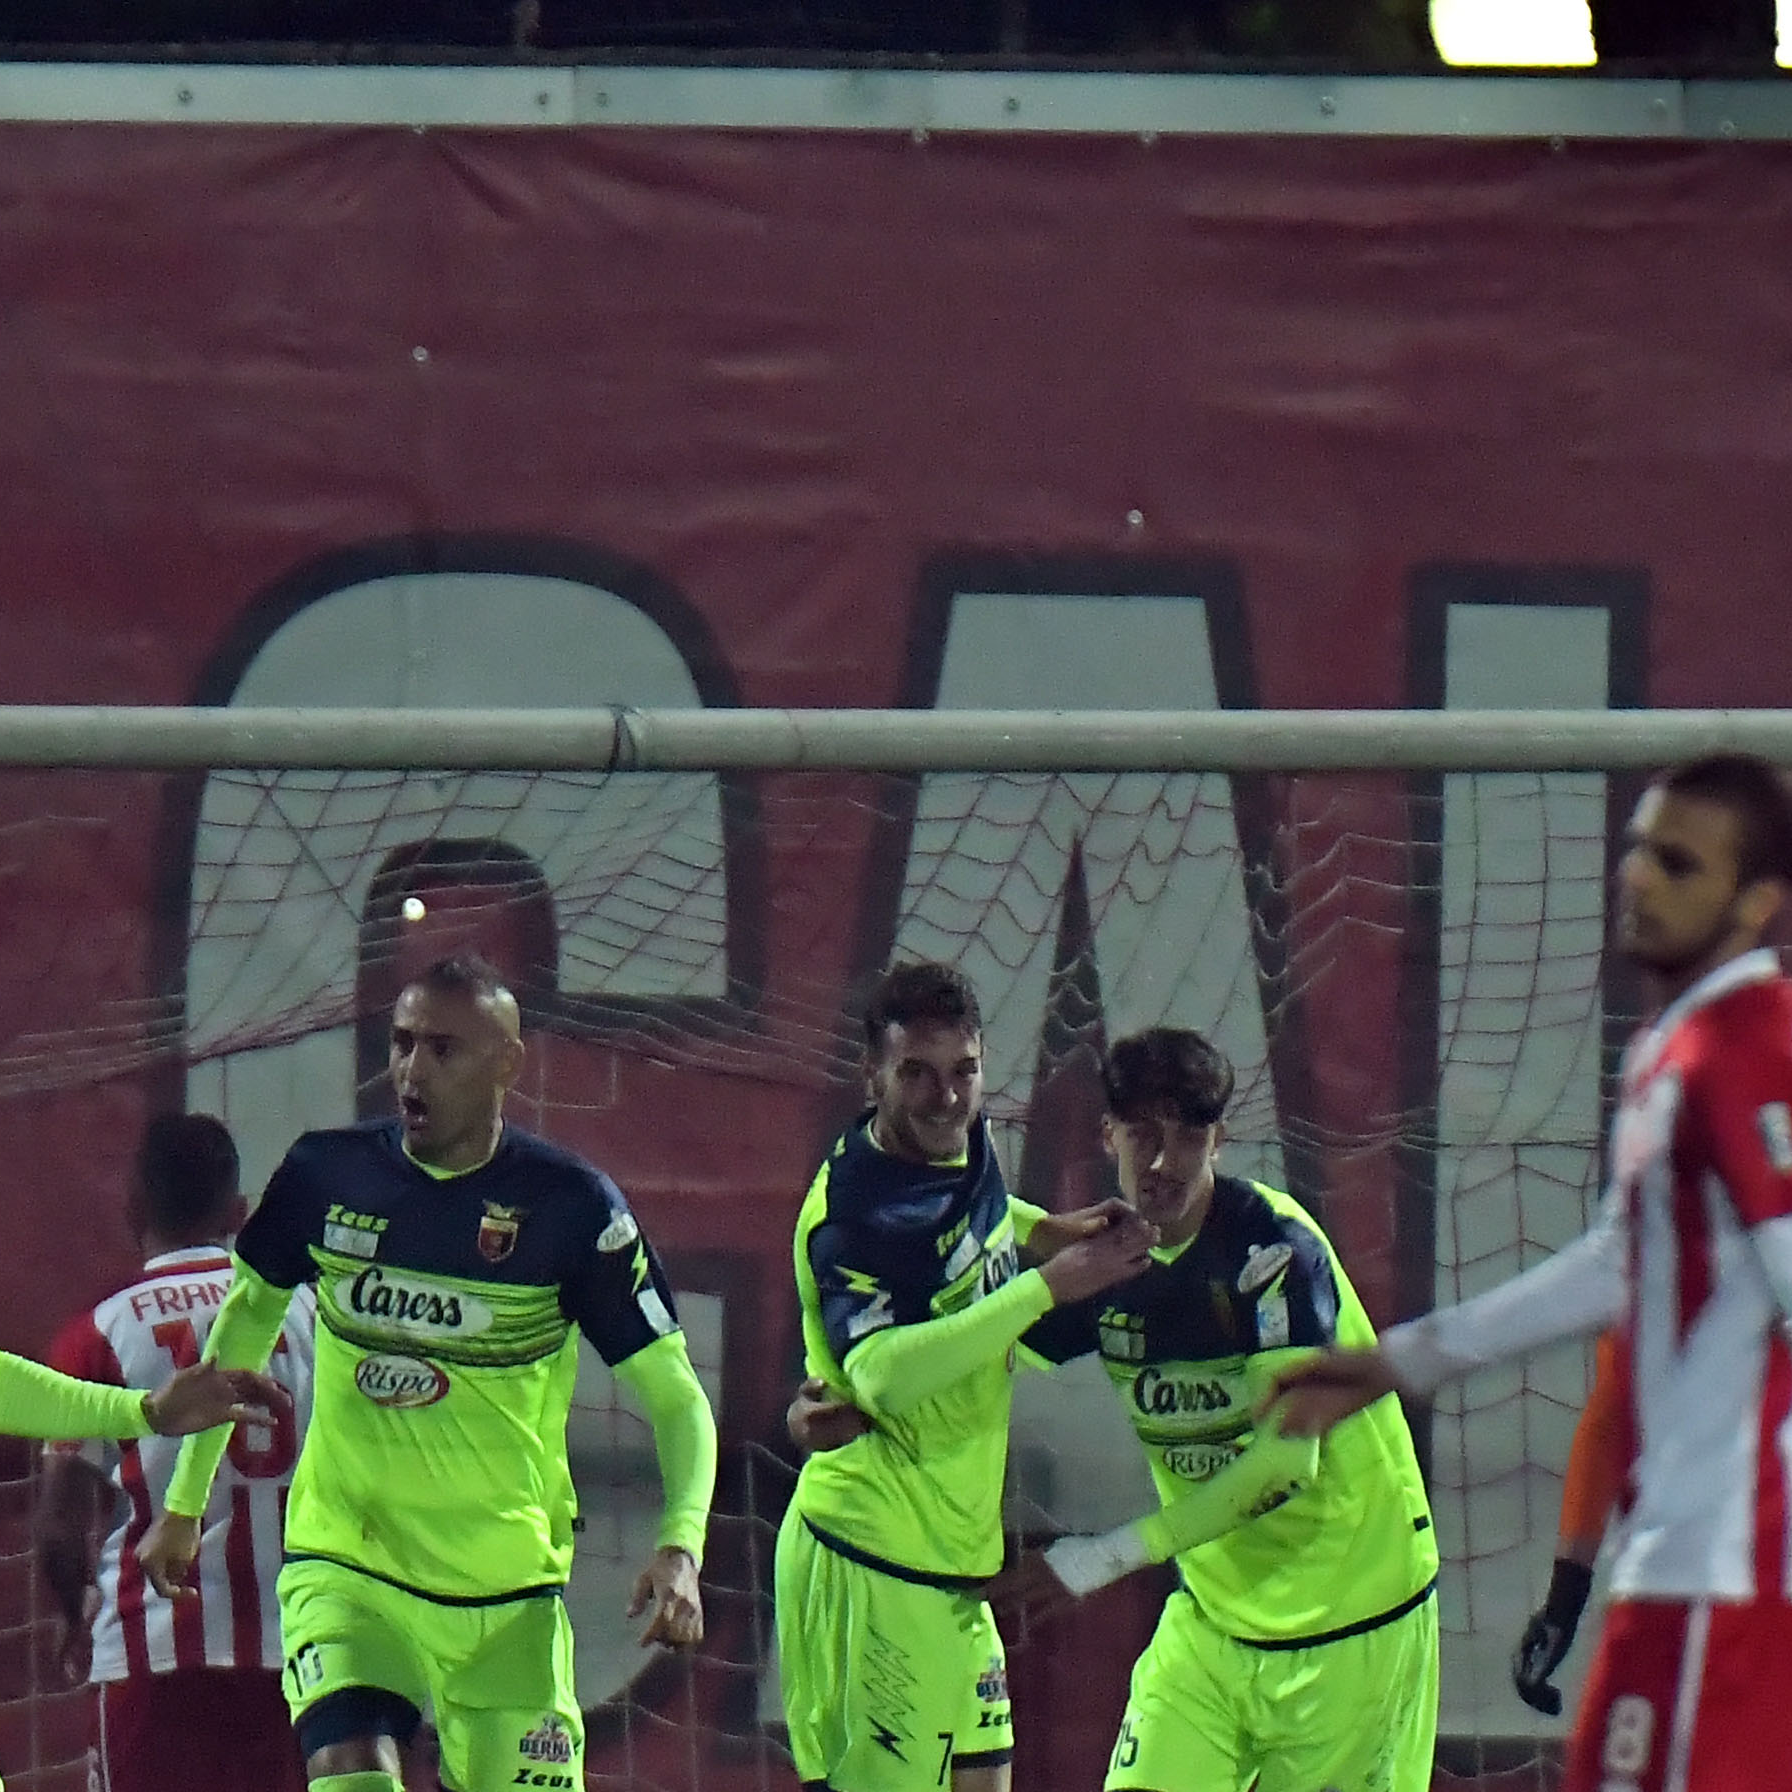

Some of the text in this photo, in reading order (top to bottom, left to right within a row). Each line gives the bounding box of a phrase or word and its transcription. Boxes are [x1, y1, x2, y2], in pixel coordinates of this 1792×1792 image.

[349, 1264, 464, 1327] Caress
[358, 1363, 437, 1397] Rispo
[937, 1731, 954, 1787] 7
[1601, 1692, 1656, 1775] 8
[511, 1767, 574, 1790] Zeus
